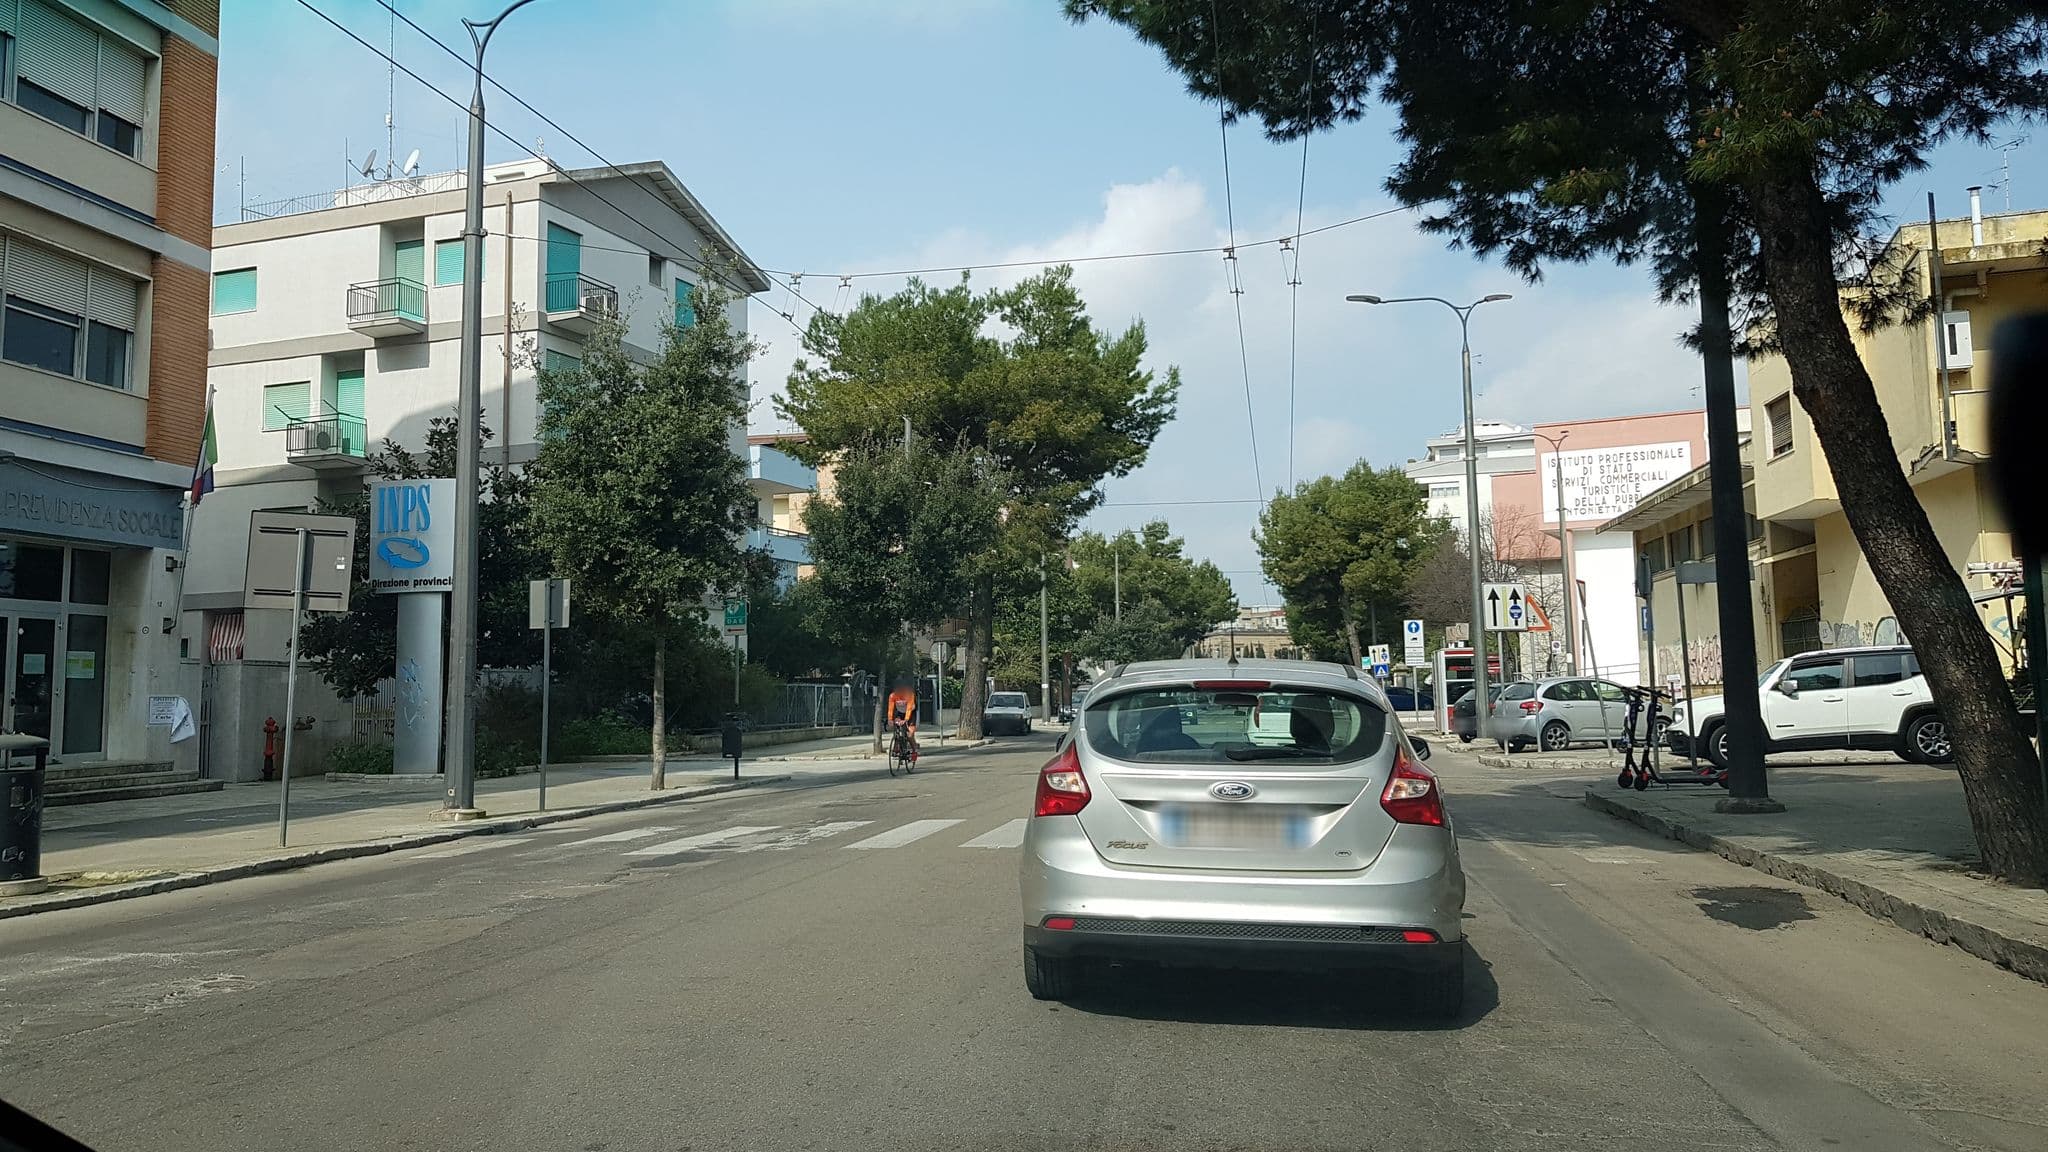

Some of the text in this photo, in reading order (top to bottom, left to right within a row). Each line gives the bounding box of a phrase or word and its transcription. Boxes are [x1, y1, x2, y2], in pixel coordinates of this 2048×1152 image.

[1548, 448, 1684, 469] ISTITUTO PROFESSIONALE
[1582, 463, 1632, 476] DI STATO
[1552, 470, 1668, 488] SRVIZI COMMERCIALI
[1582, 483, 1640, 496] TURISTICI E
[1575, 496, 1607, 507] DELLA
[377, 484, 431, 533] INPS
[1566, 504, 1622, 516] NTONIETTA
[5, 491, 179, 540] PREVIDENZA SOCIALE
[371, 577, 409, 588] Direzione
[1221, 785, 1244, 796] Ford
